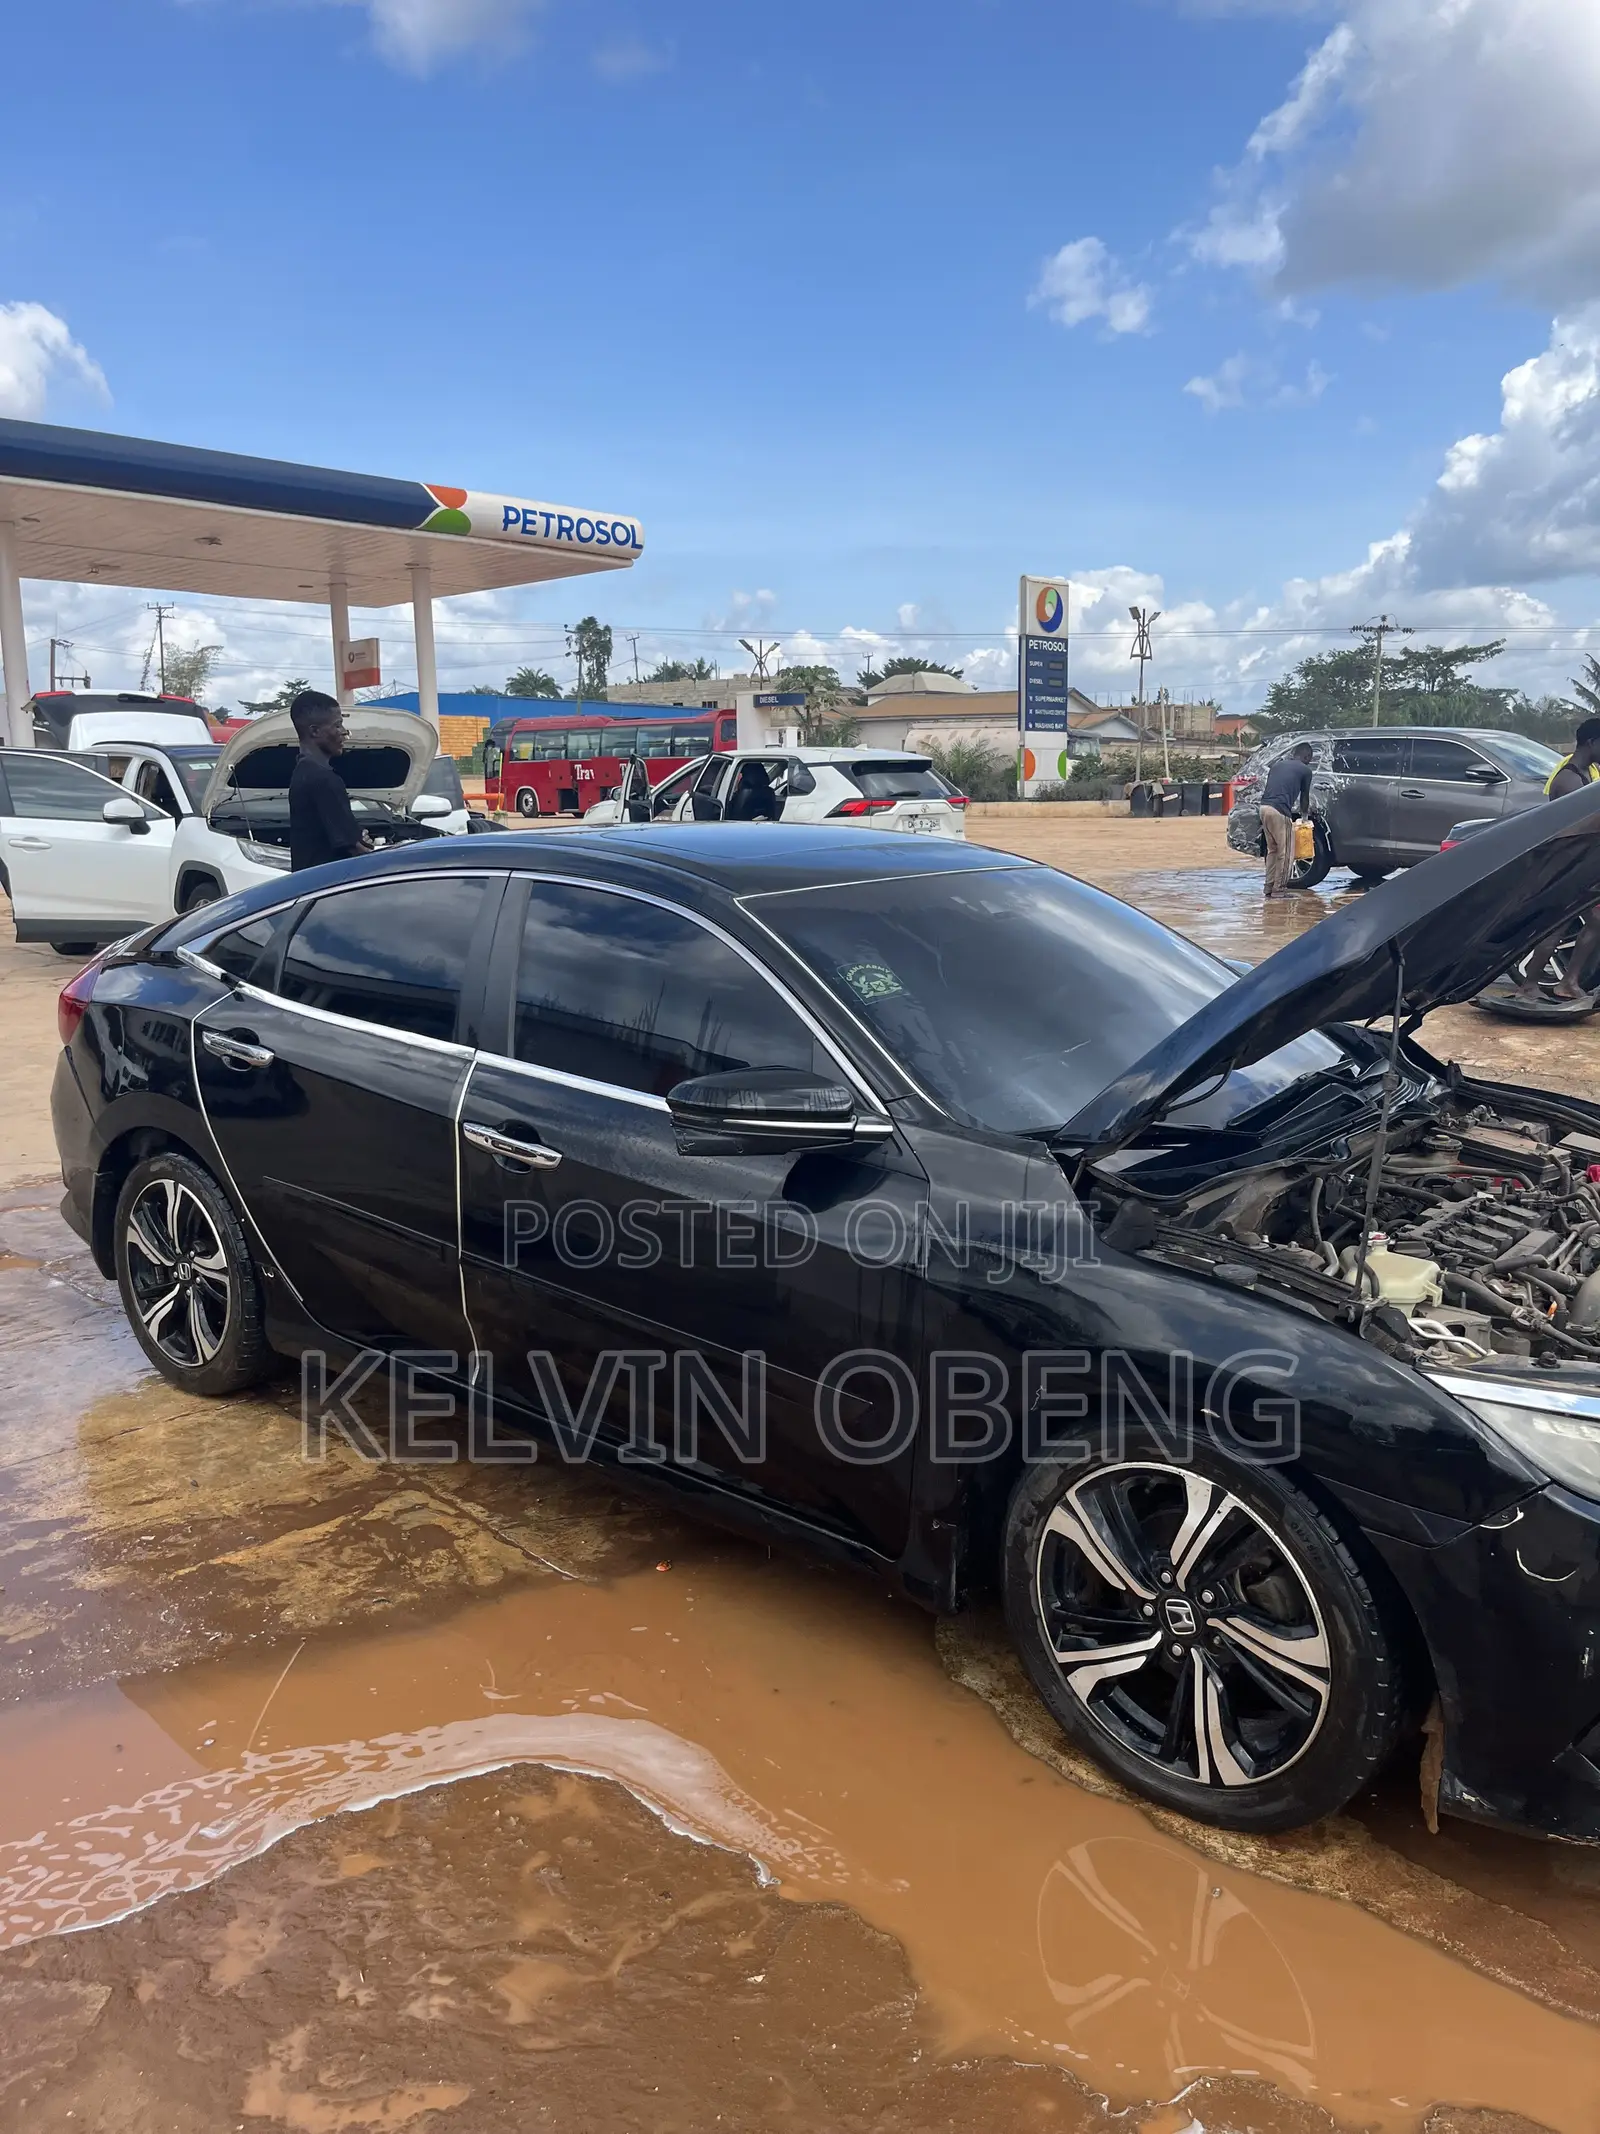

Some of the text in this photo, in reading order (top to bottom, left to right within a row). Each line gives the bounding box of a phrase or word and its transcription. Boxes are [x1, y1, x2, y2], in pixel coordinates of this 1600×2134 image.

[502, 505, 644, 550] PETROSOL
[1029, 639, 1067, 652] PETROSOL
[759, 696, 779, 704] DIESEL
[845, 963, 891, 982] GHANA ARMY
